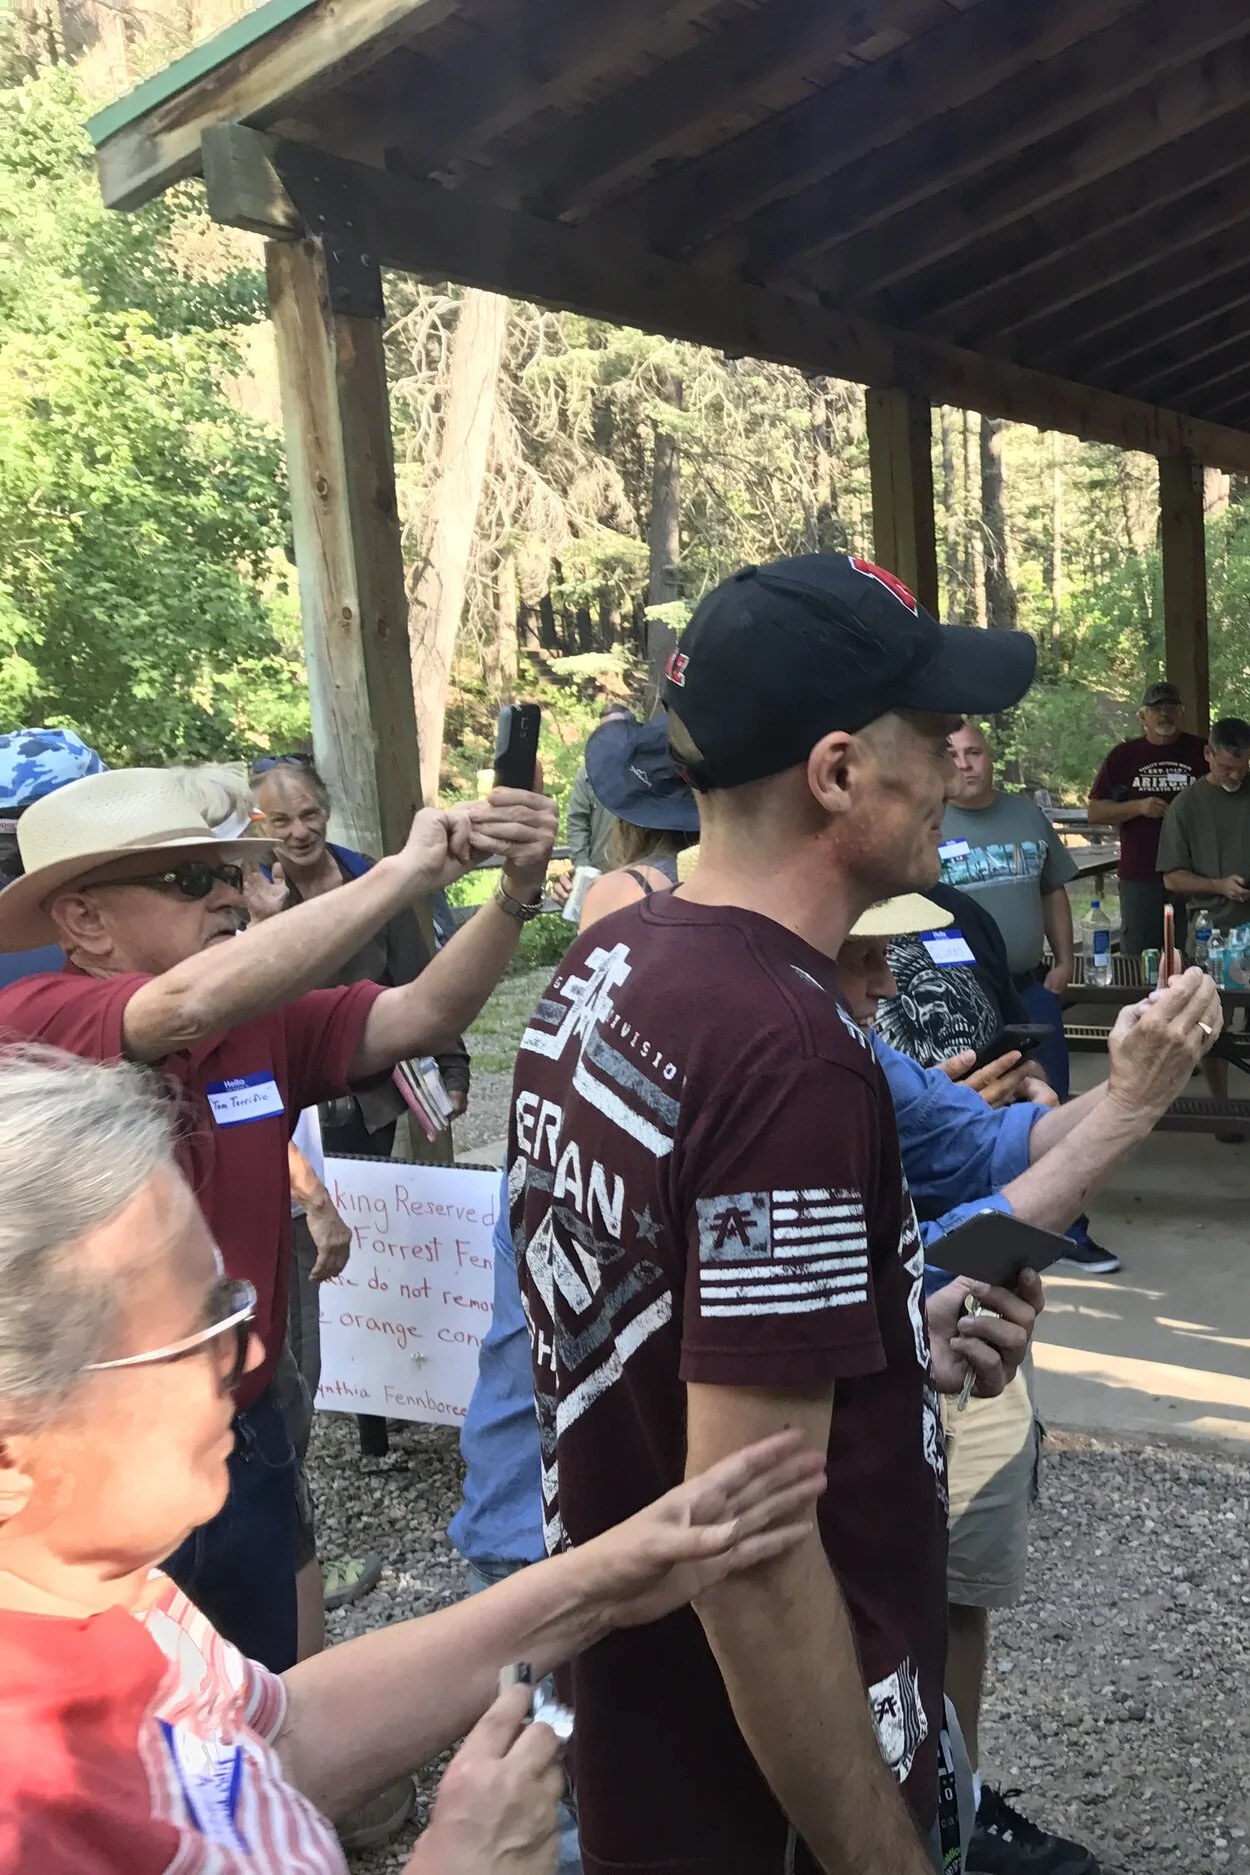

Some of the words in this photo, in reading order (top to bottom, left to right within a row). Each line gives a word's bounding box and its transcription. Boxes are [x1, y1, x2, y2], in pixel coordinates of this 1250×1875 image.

[223, 1078, 246, 1088] Hello
[212, 1100, 229, 1111] Tom
[515, 1090, 625, 1240] ERAN
[334, 1179, 390, 1234] king
[395, 1184, 495, 1227] Reserved
[354, 1225, 443, 1262] Forrest
[455, 1238, 493, 1271] Fen
[368, 1266, 389, 1291] do
[400, 1277, 432, 1299] not
[443, 1290, 494, 1313] remo
[340, 1312, 424, 1350] orange
[438, 1328, 485, 1347] con
[316, 1380, 372, 1399] ynthia
